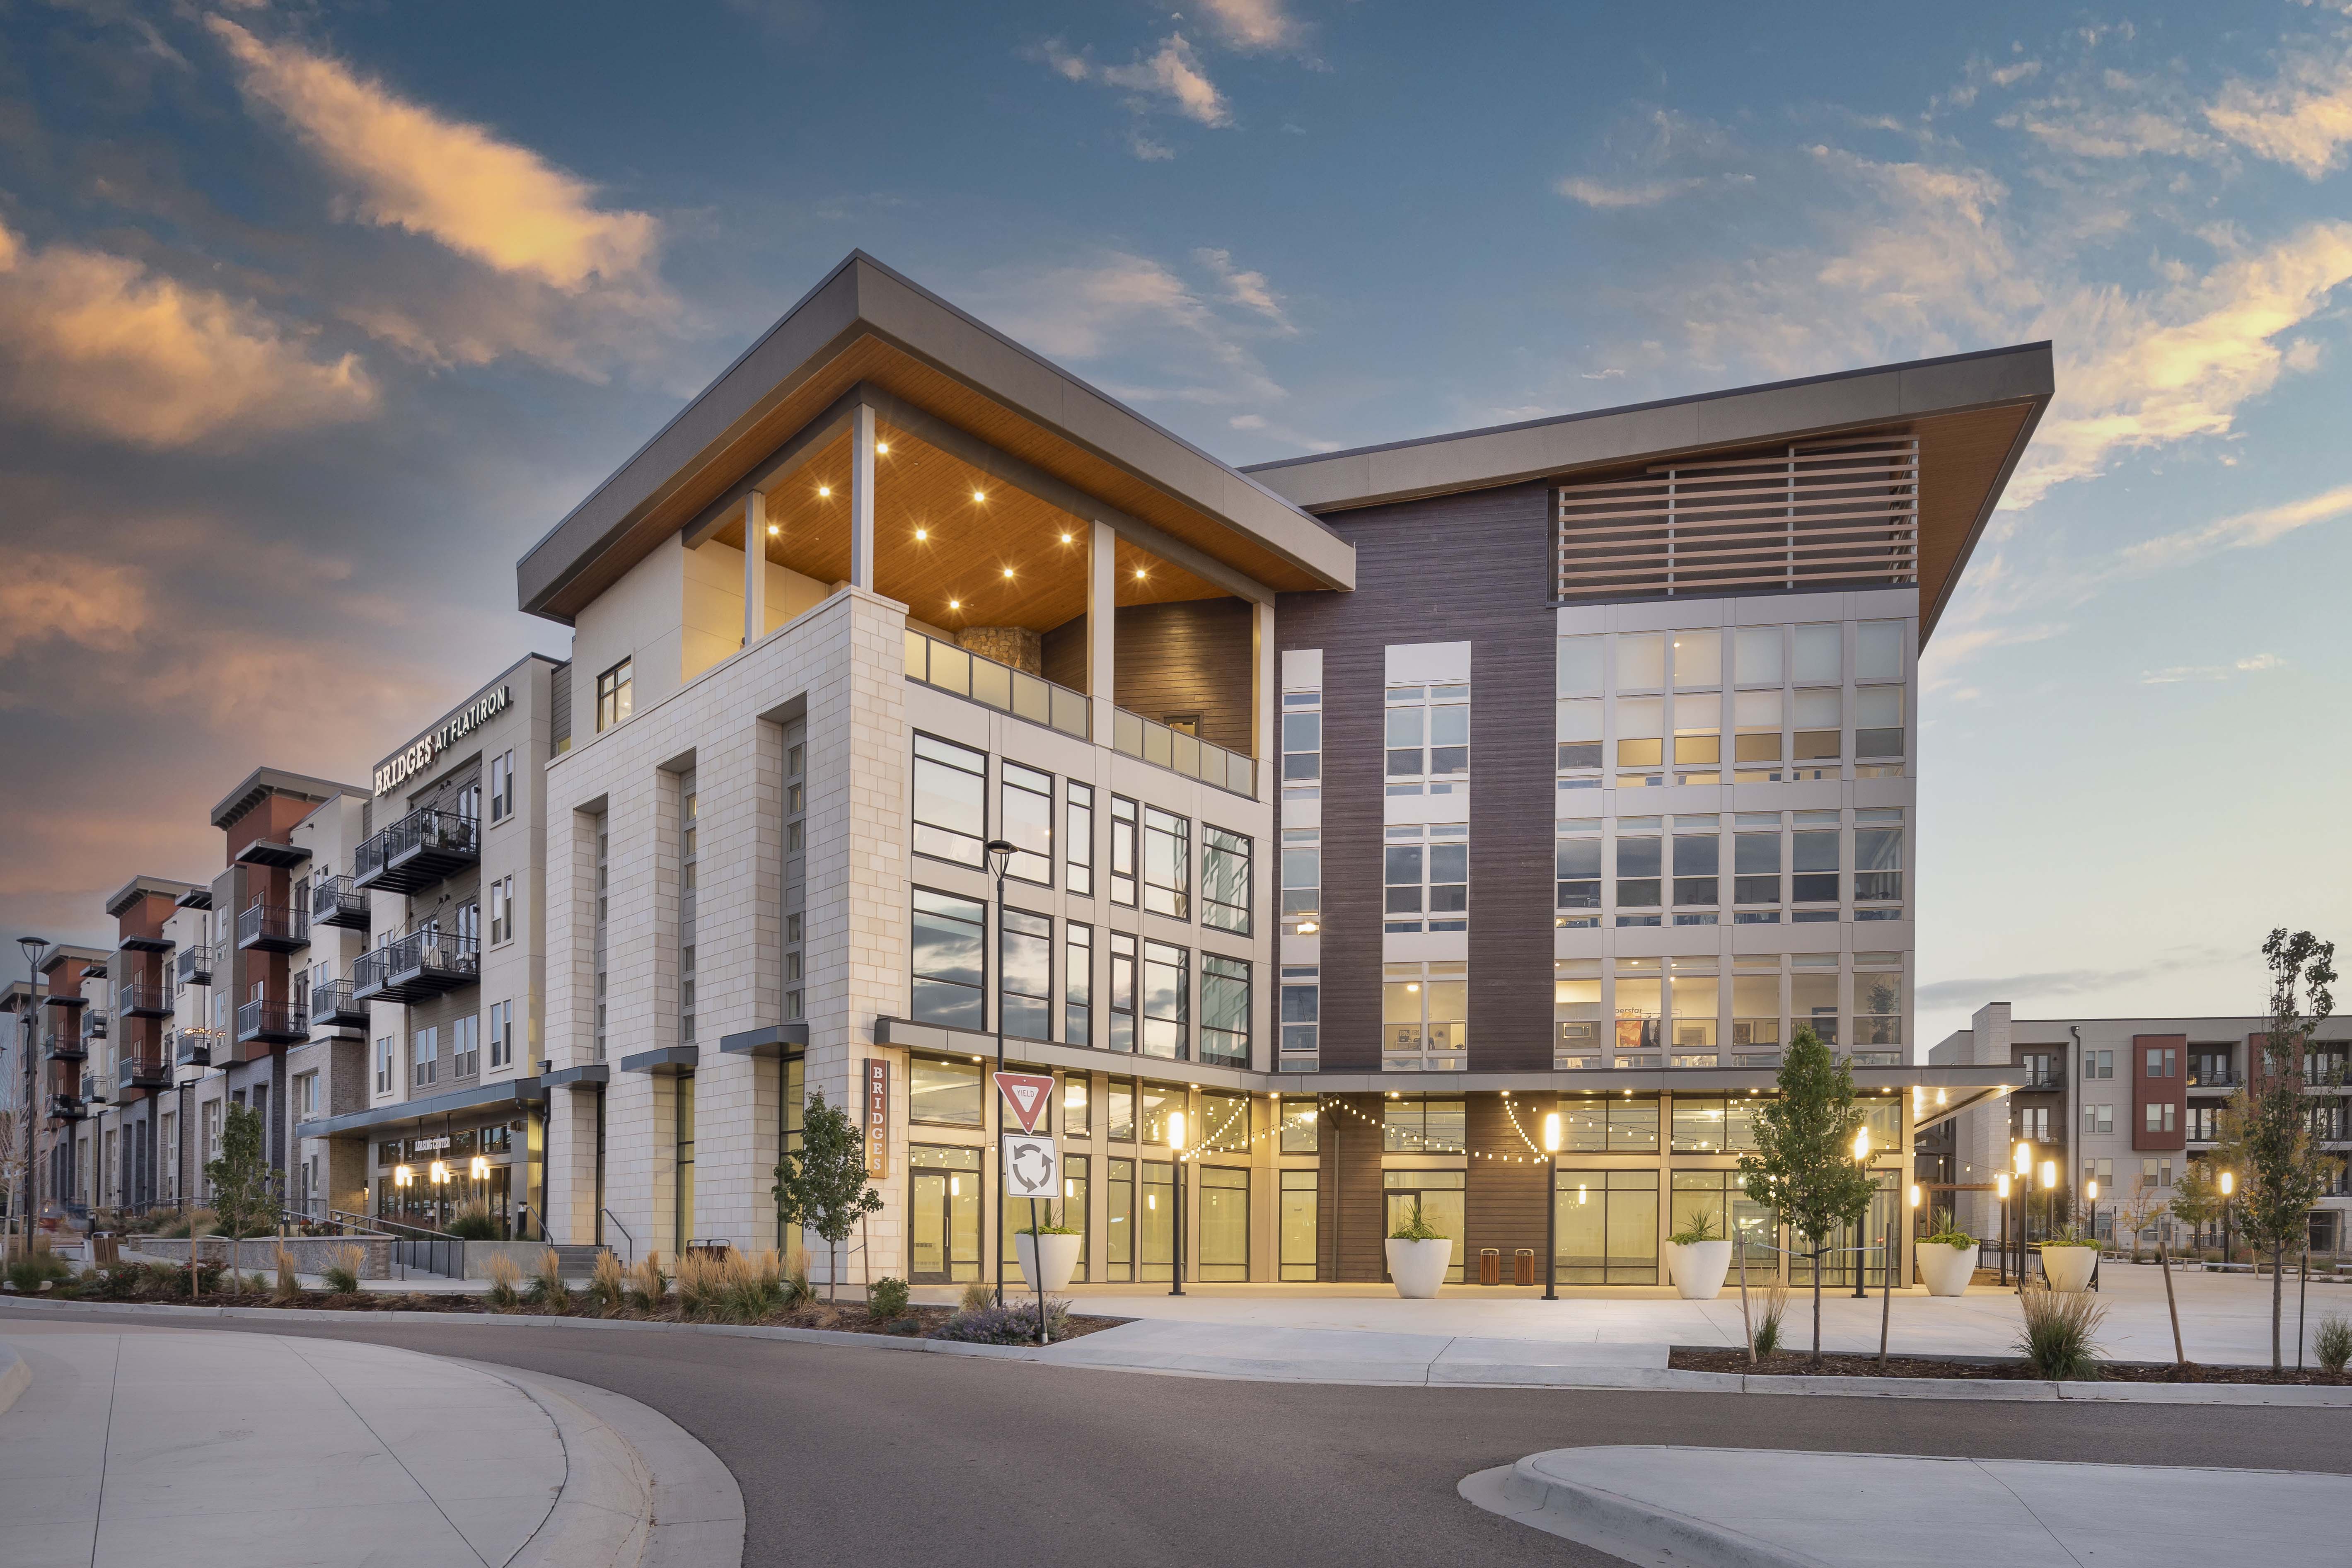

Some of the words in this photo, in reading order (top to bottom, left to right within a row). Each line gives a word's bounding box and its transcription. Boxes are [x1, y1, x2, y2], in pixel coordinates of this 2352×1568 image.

[375, 734, 432, 797] BRIDGES
[435, 731, 448, 753] AT
[451, 685, 505, 742] FLATIRON
[872, 1066, 883, 1170] BRIDGES
[1016, 1089, 1035, 1097] YIELD
[415, 1138, 432, 1152] LEASING
[433, 1137, 450, 1150] CENTER
